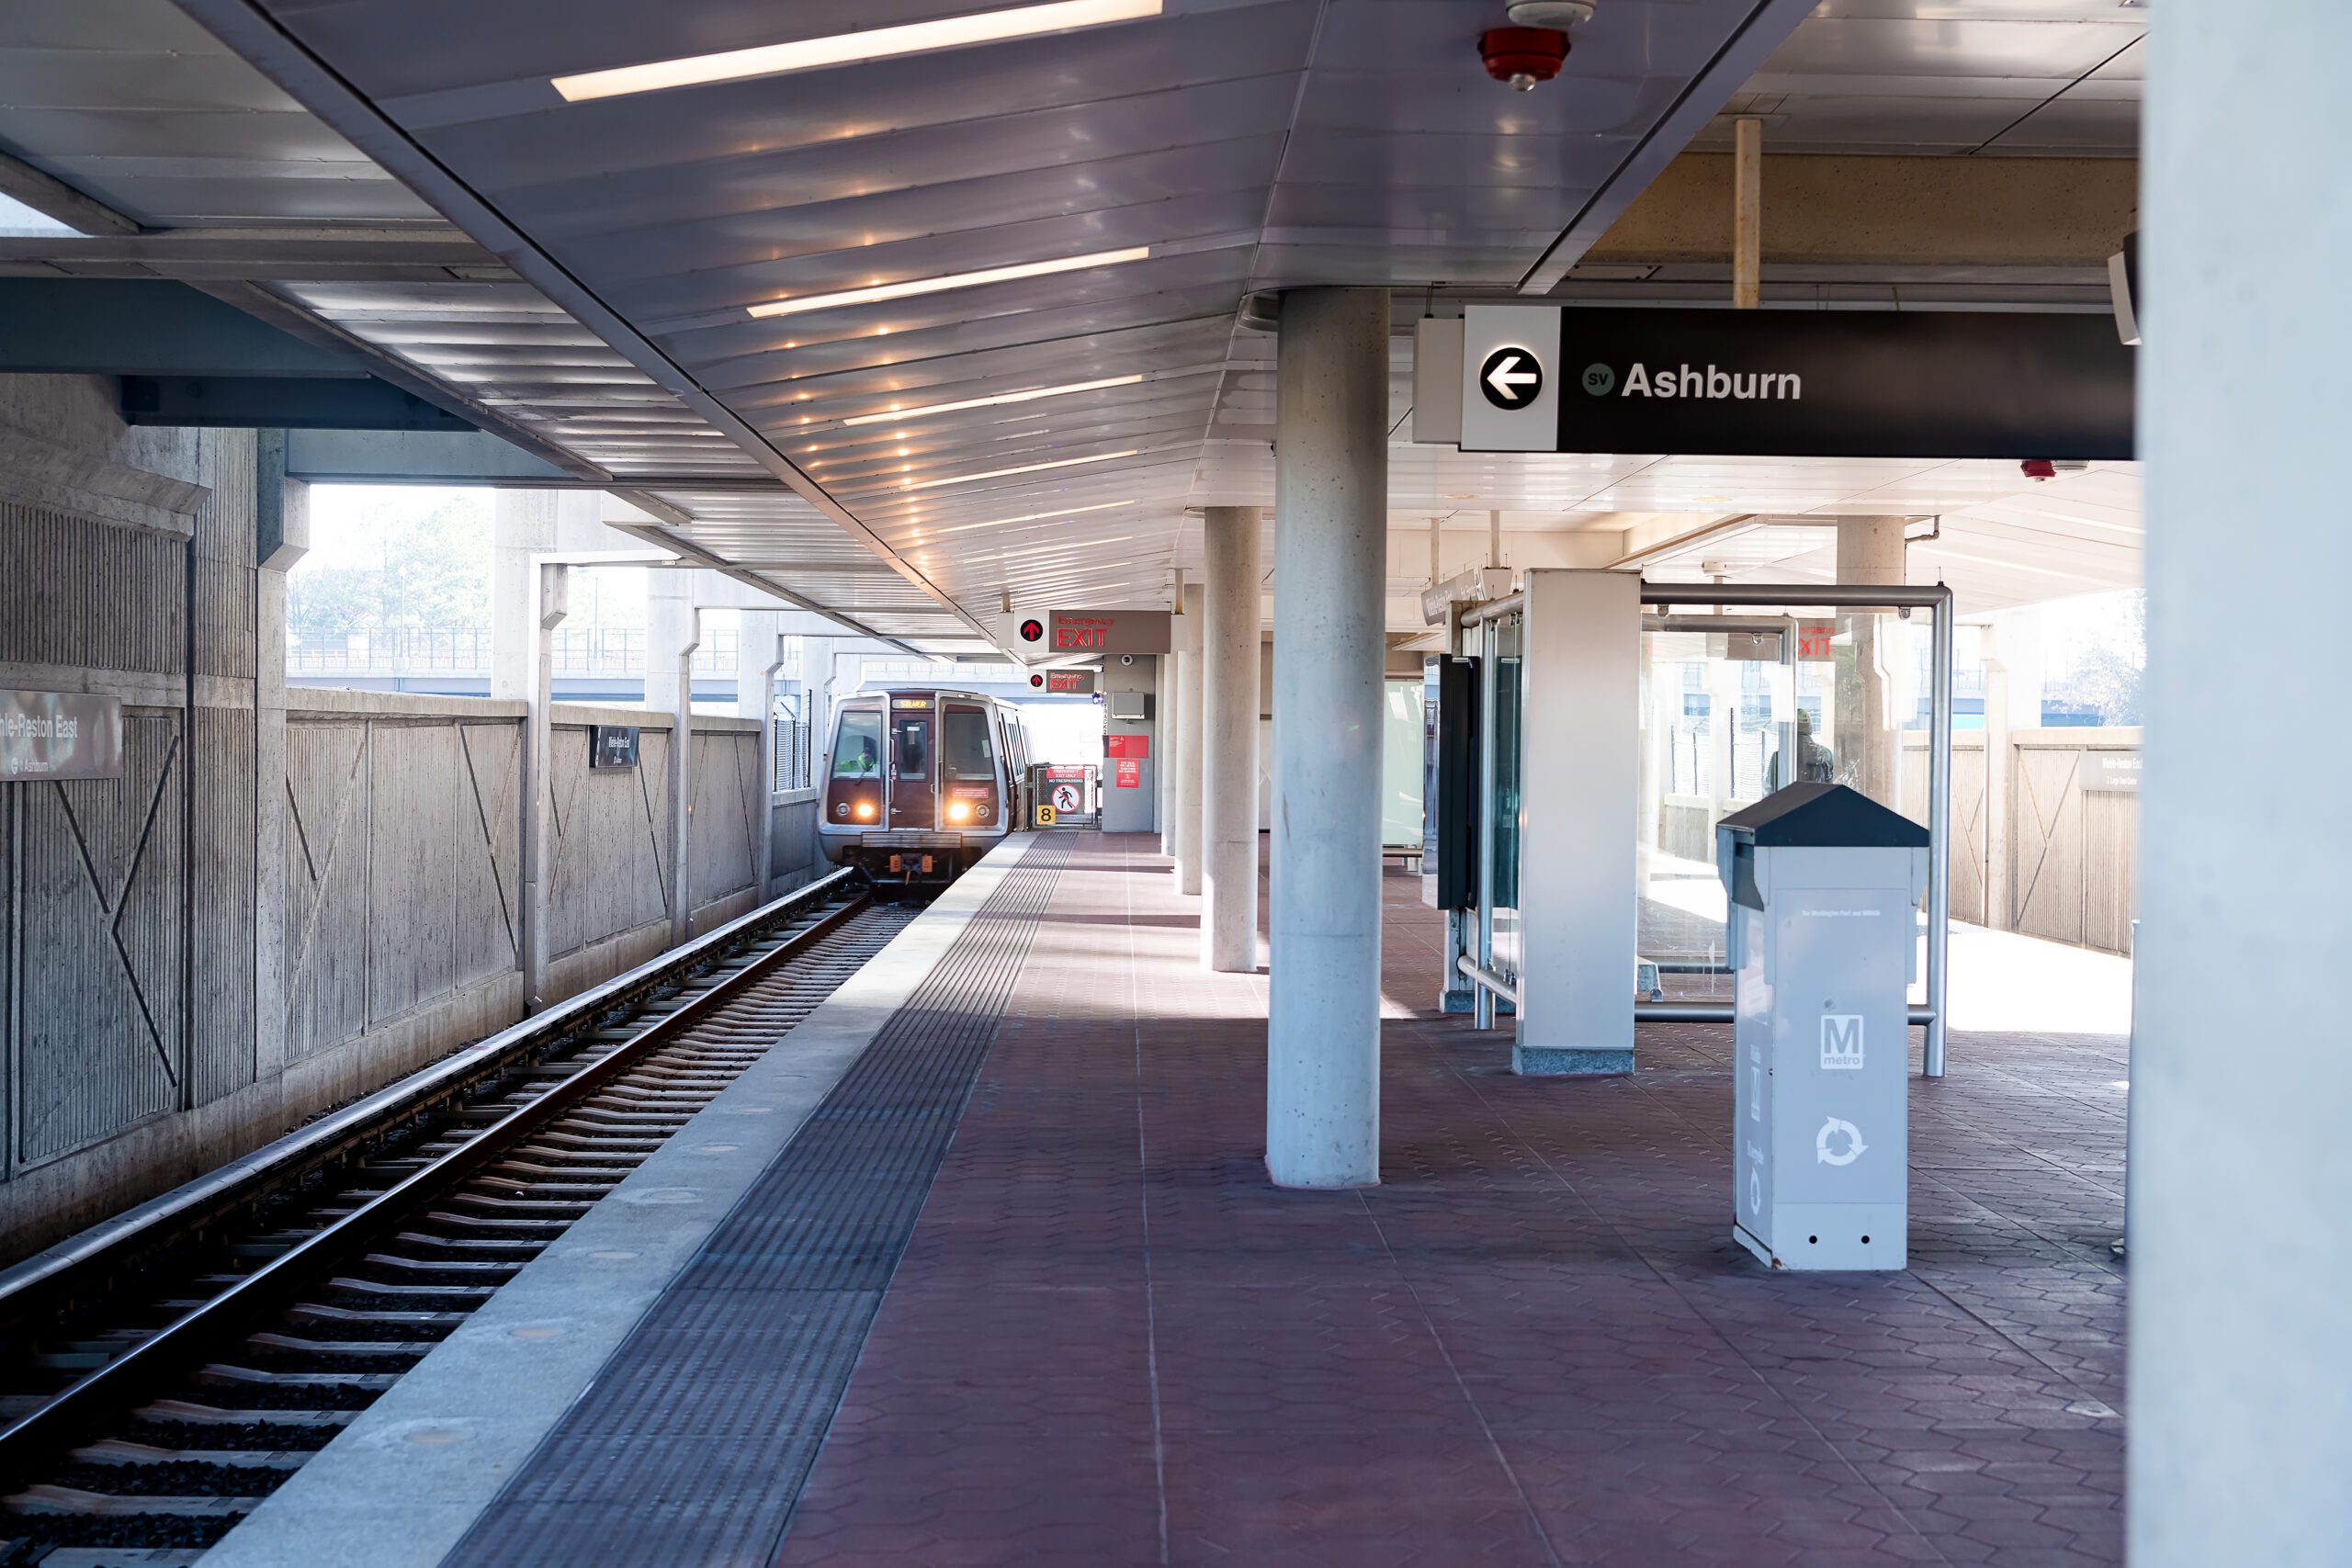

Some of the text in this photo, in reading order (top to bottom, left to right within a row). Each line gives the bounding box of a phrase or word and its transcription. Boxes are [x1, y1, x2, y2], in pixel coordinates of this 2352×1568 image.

[1588, 363, 1802, 400] SV Ashburn
[1057, 616, 1114, 626] Emergency
[1057, 628, 1108, 647] EXIT
[1798, 638, 1831, 657] XIT
[1050, 680, 1079, 690] EXIT
[56, 715, 78, 739] East
[1041, 807, 1052, 822] 8
[1824, 1019, 1860, 1055] M
[1824, 1056, 1860, 1066] metro
